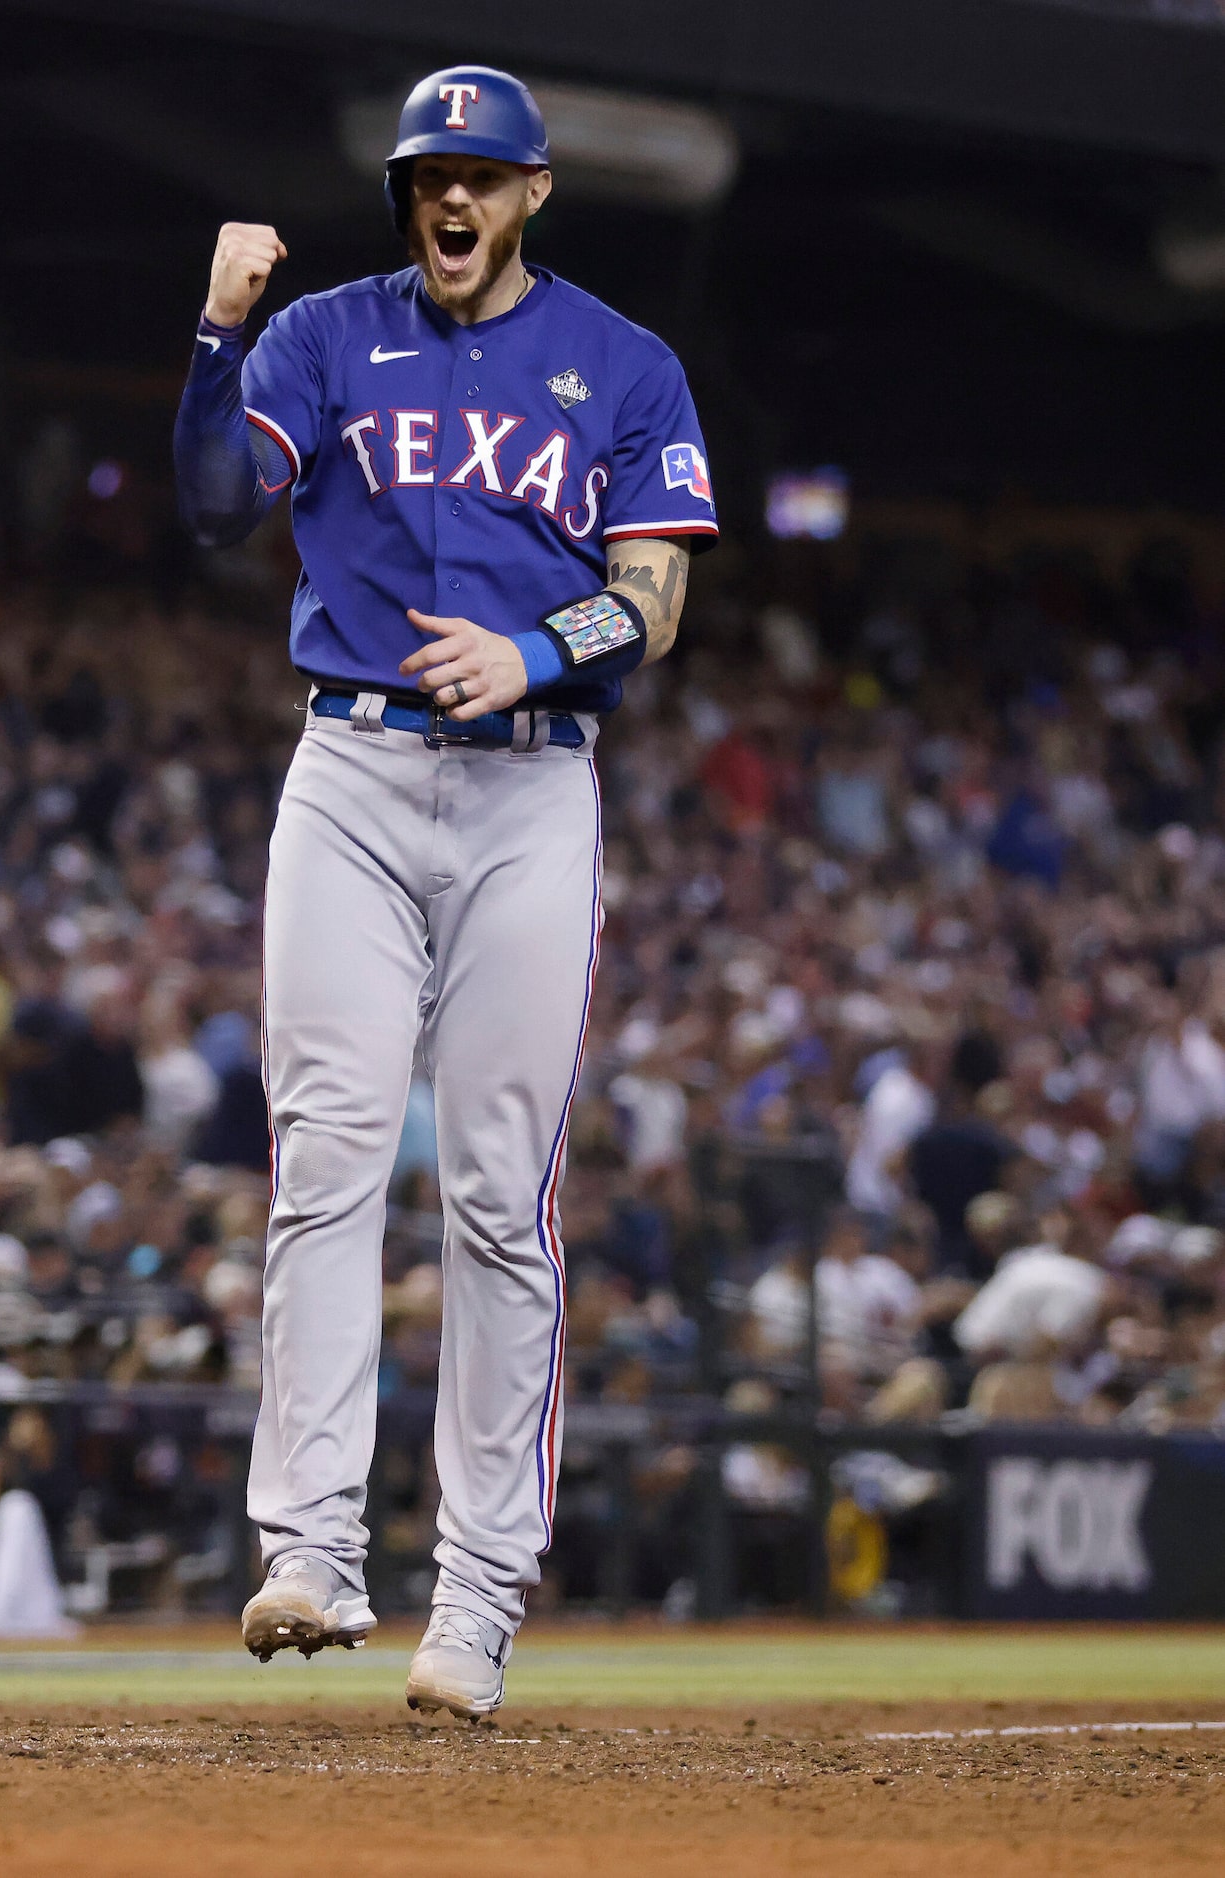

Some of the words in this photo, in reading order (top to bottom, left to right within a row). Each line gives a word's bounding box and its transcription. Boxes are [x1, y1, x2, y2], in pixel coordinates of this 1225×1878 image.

[439, 84, 480, 130] T
[550, 384, 587, 402] SERIES
[552, 376, 588, 394] WORLD
[340, 408, 612, 542] TEXAS
[986, 1459, 1156, 1587] FOX
